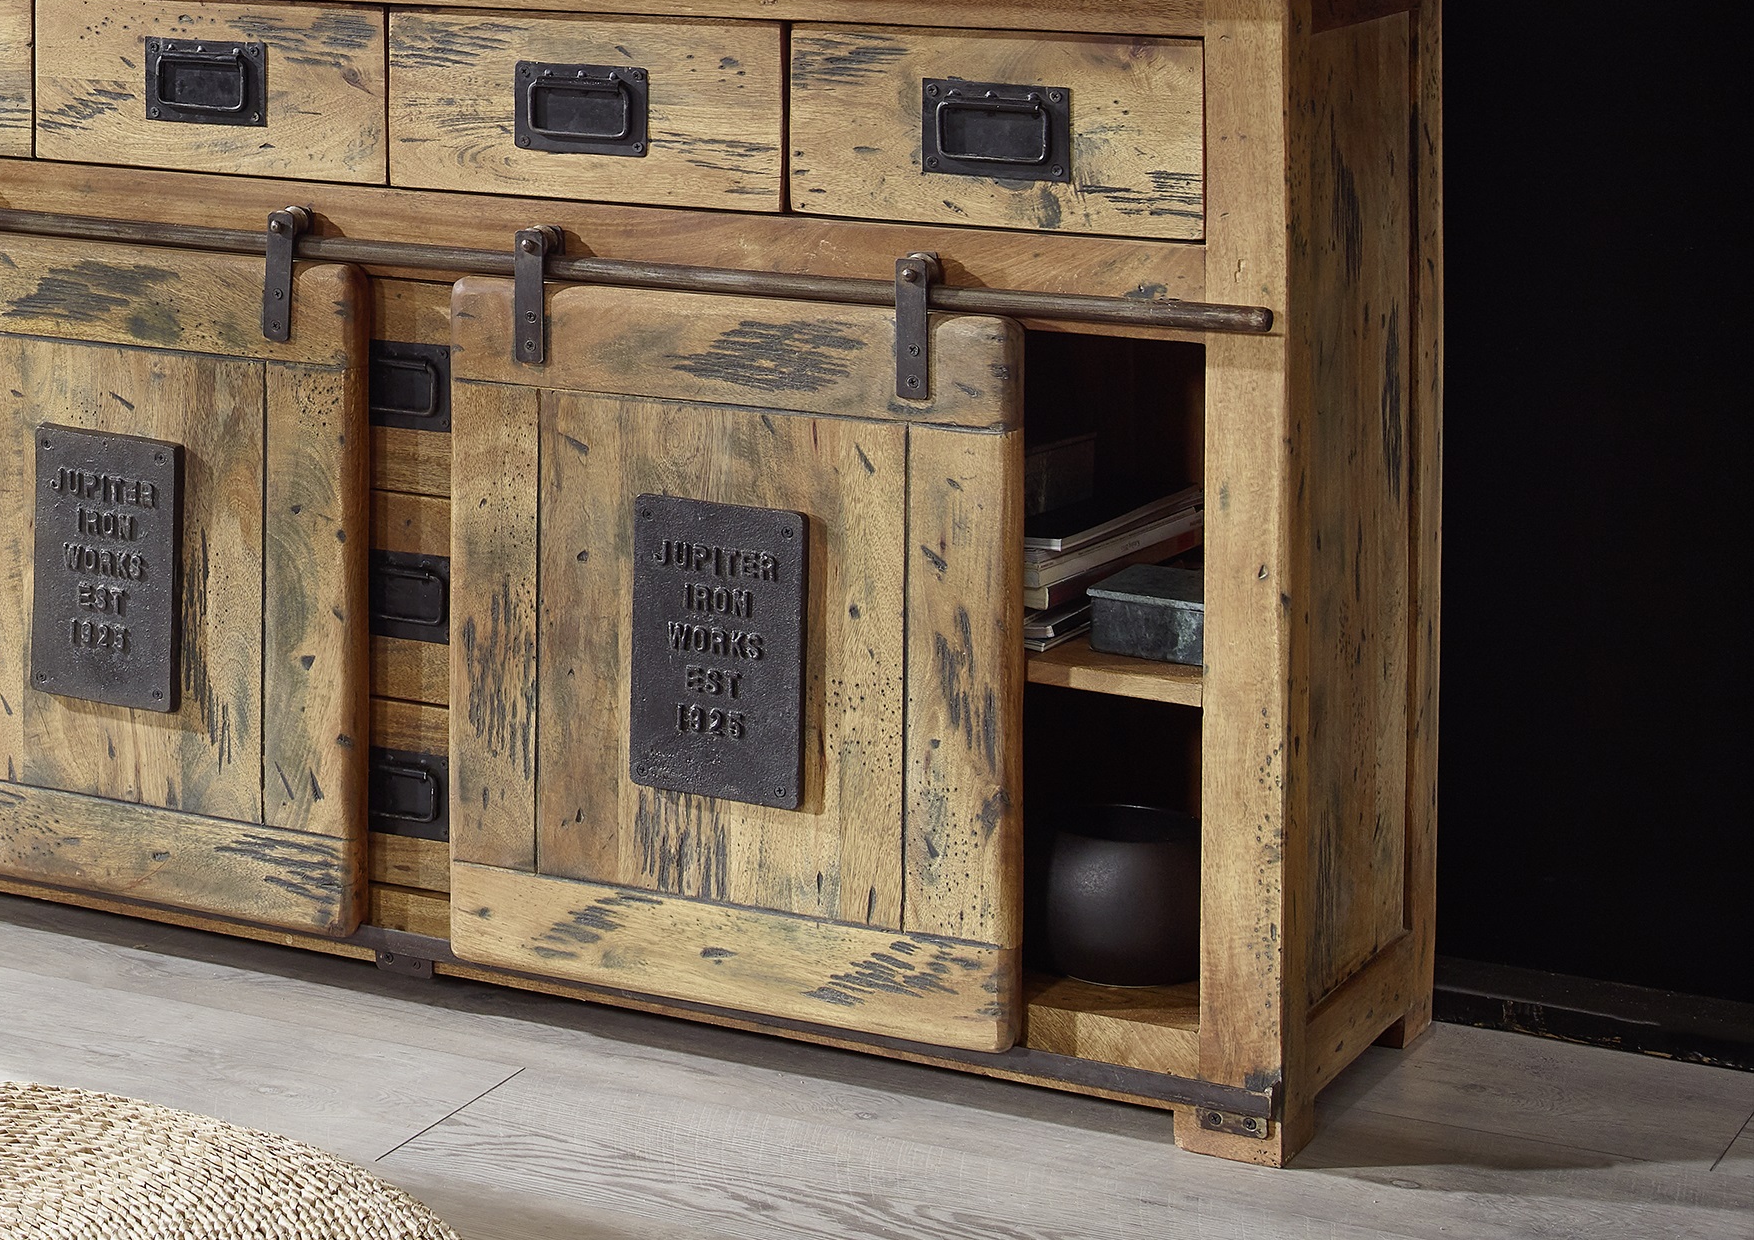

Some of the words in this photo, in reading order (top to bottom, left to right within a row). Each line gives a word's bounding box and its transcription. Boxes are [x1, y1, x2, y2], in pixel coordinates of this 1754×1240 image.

[49, 465, 159, 510] JUPITER
[76, 507, 137, 542] IRON
[62, 541, 145, 581] WORKS
[652, 538, 779, 583] JUPITER
[78, 581, 129, 615] EST
[683, 582, 754, 618] IRON
[69, 616, 130, 650] 1925
[666, 620, 764, 661] WORKS
[684, 663, 744, 700] EST
[675, 702, 748, 740] 1925
